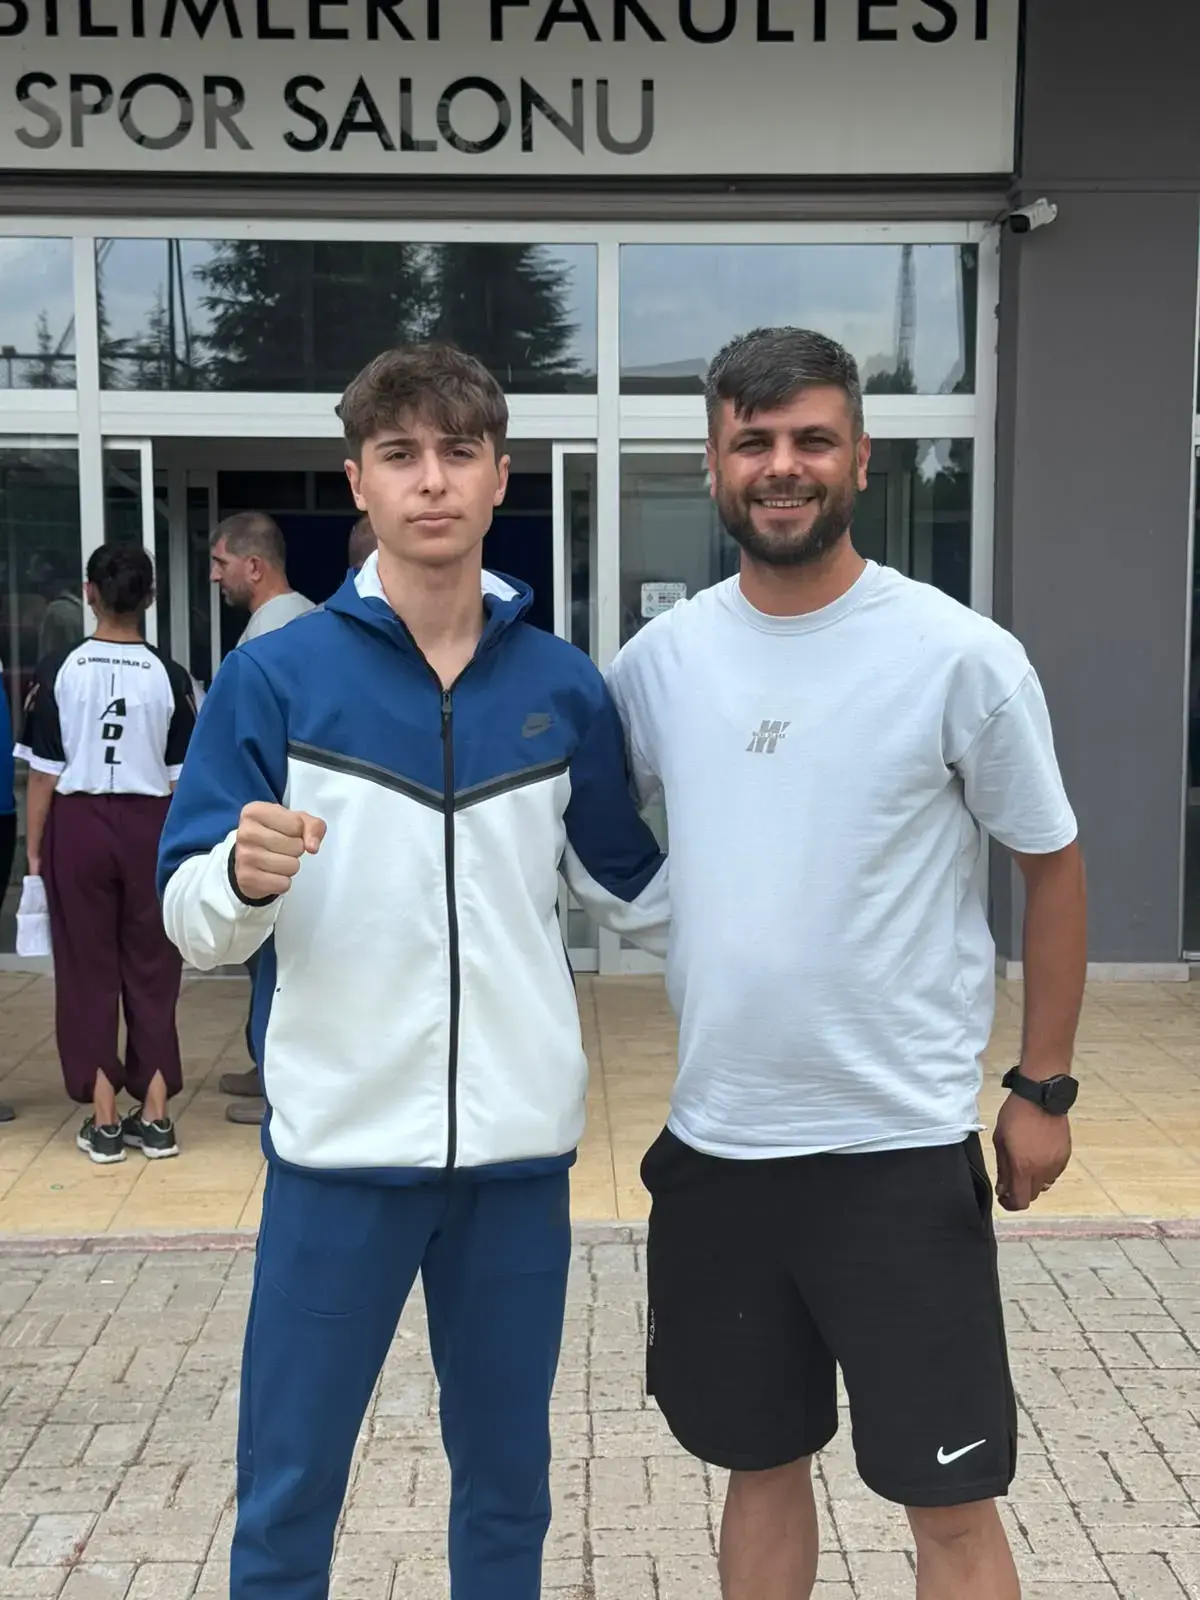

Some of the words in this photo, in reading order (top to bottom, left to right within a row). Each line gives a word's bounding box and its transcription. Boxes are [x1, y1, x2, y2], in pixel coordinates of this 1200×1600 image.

[14, 72, 254, 150] SPOR
[282, 75, 656, 155] SALONU
[99, 698, 127, 765] ADL
